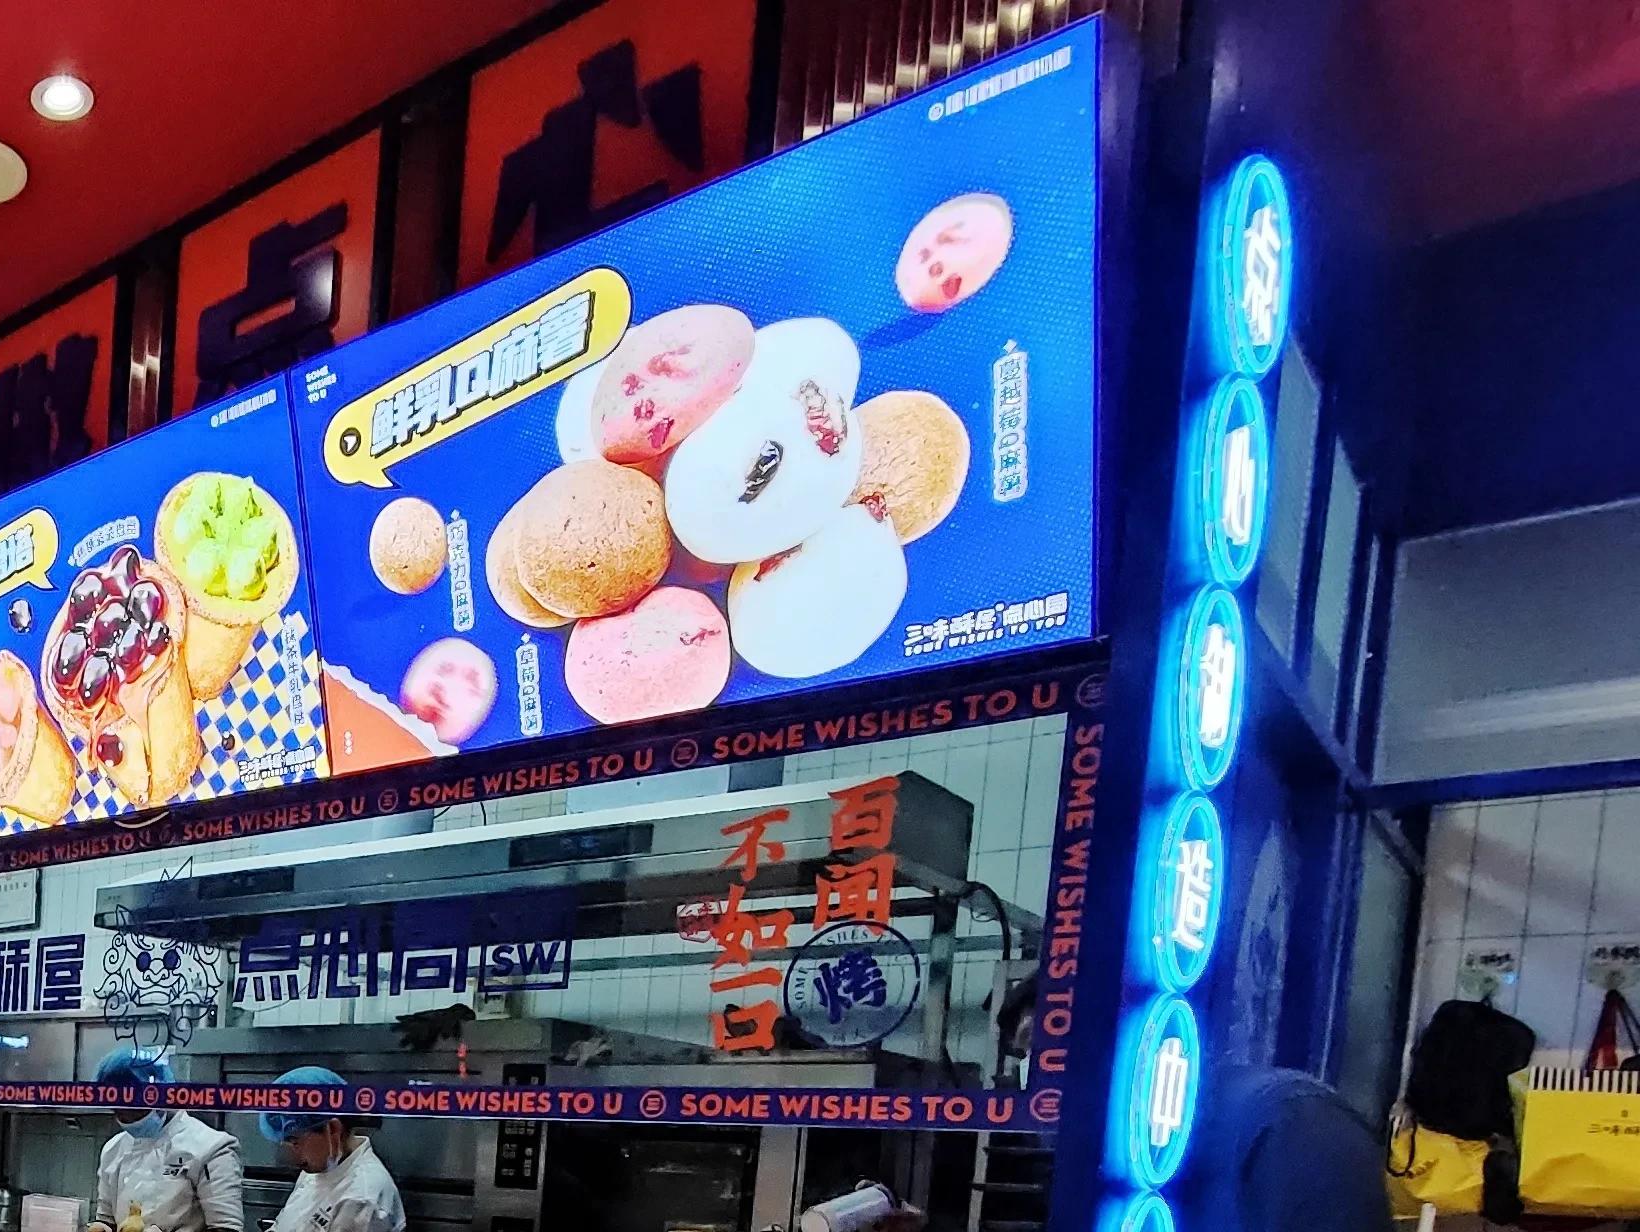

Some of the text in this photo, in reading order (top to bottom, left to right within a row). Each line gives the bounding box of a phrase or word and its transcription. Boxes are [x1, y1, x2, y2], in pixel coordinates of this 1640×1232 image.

[713, 682, 1060, 760] SOME WISHES TO U
[409, 747, 654, 806] SOME WISHES TO U
[183, 796, 365, 841] SOME WISHES TO U
[9, 847, 49, 869] SOME
[52, 837, 110, 862] WISHES
[111, 834, 134, 852] TO
[813, 776, 901, 936] 百闻
[1039, 723, 1106, 1073] SOME WISHES TO U
[709, 809, 794, 1053] 不如一口
[491, 942, 561, 976] SW
[39, 1086, 94, 1102] WISHES
[98, 1087, 117, 1102] TO
[123, 1087, 133, 1102] U
[166, 1087, 344, 1109] SOME WISHES TO U
[385, 1089, 622, 1115] SOME WISHES TO U
[680, 1095, 1014, 1123] SOME WISHES TO U
